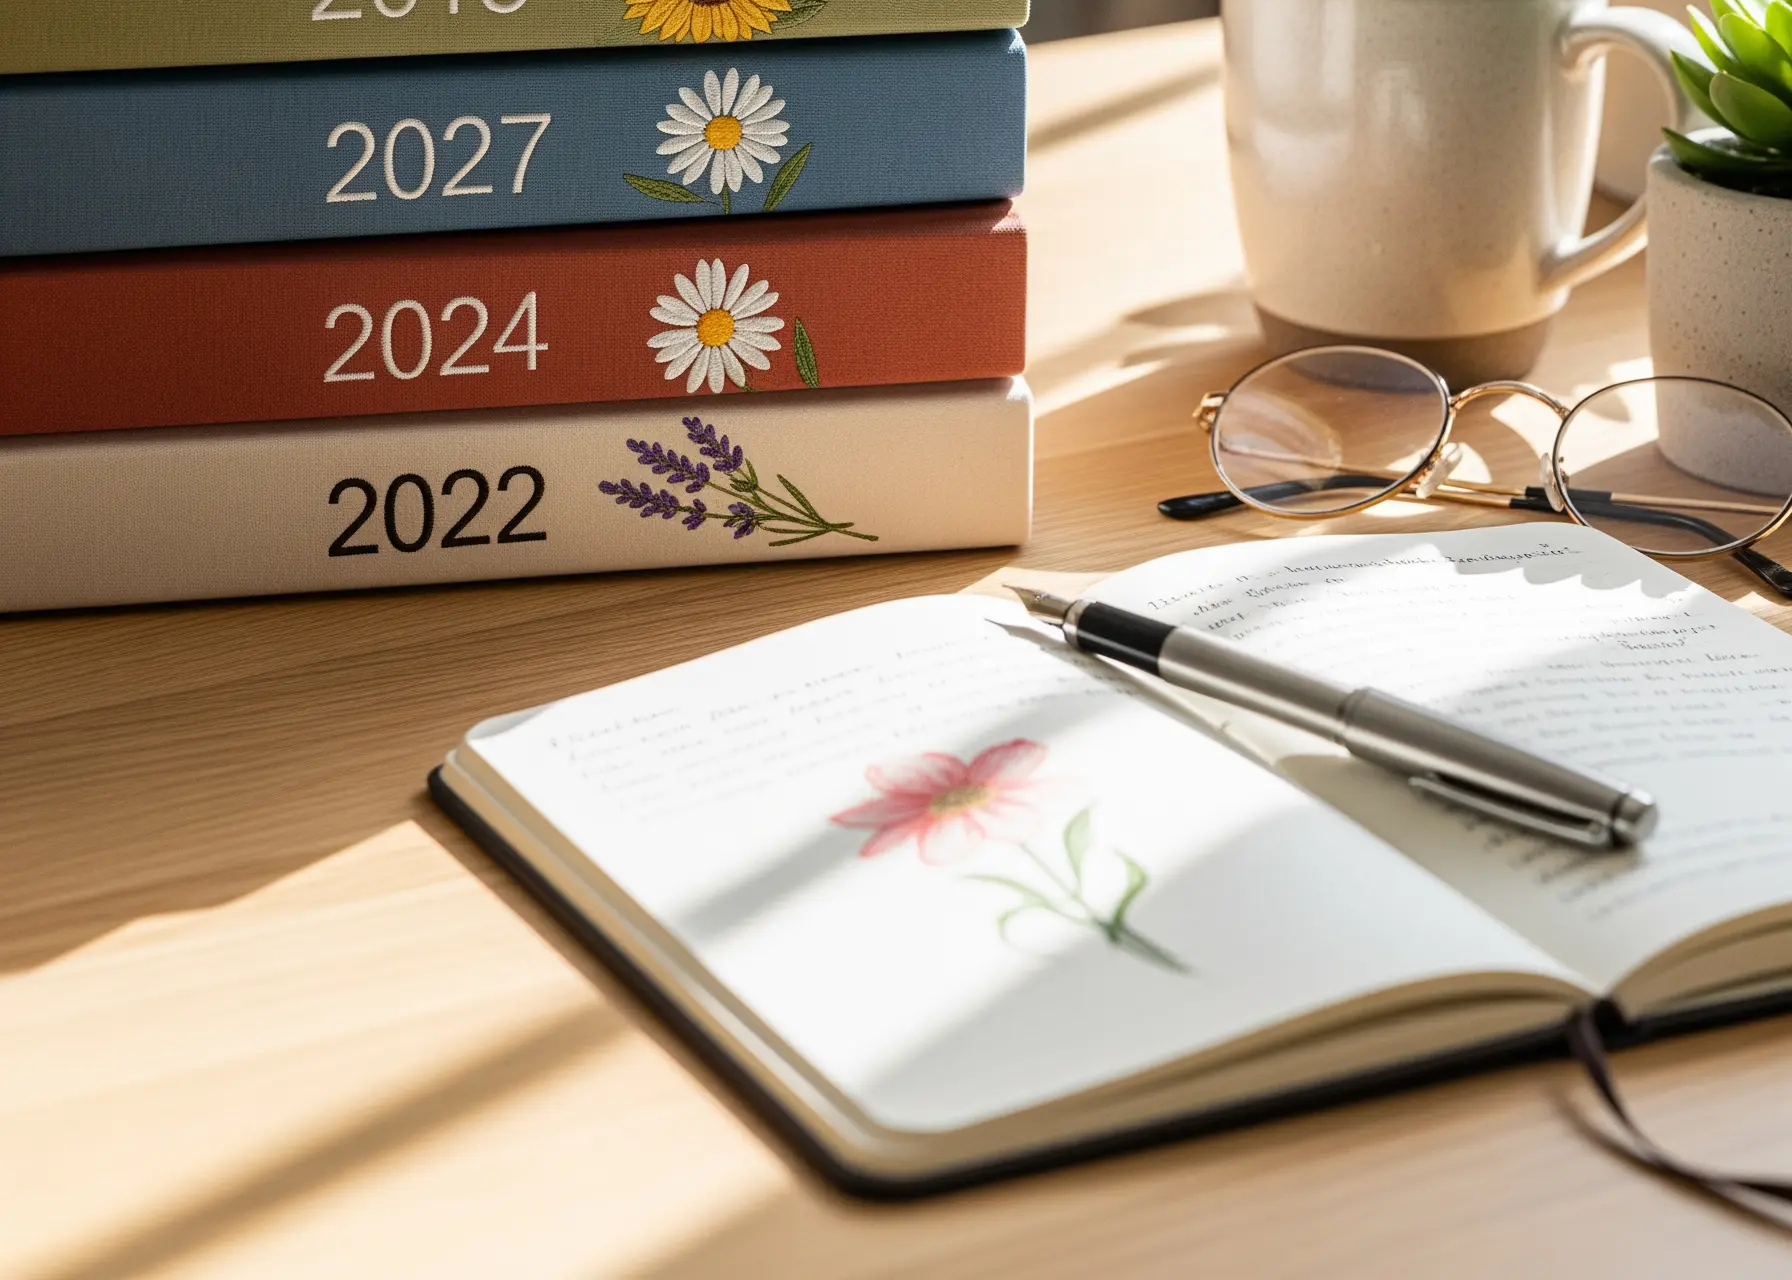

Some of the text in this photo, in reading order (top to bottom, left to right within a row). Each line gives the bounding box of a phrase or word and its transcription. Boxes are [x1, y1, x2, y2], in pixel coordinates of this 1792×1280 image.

[326, 113, 551, 202] 2027
[324, 291, 548, 382] 2024
[328, 466, 547, 557] 2022
